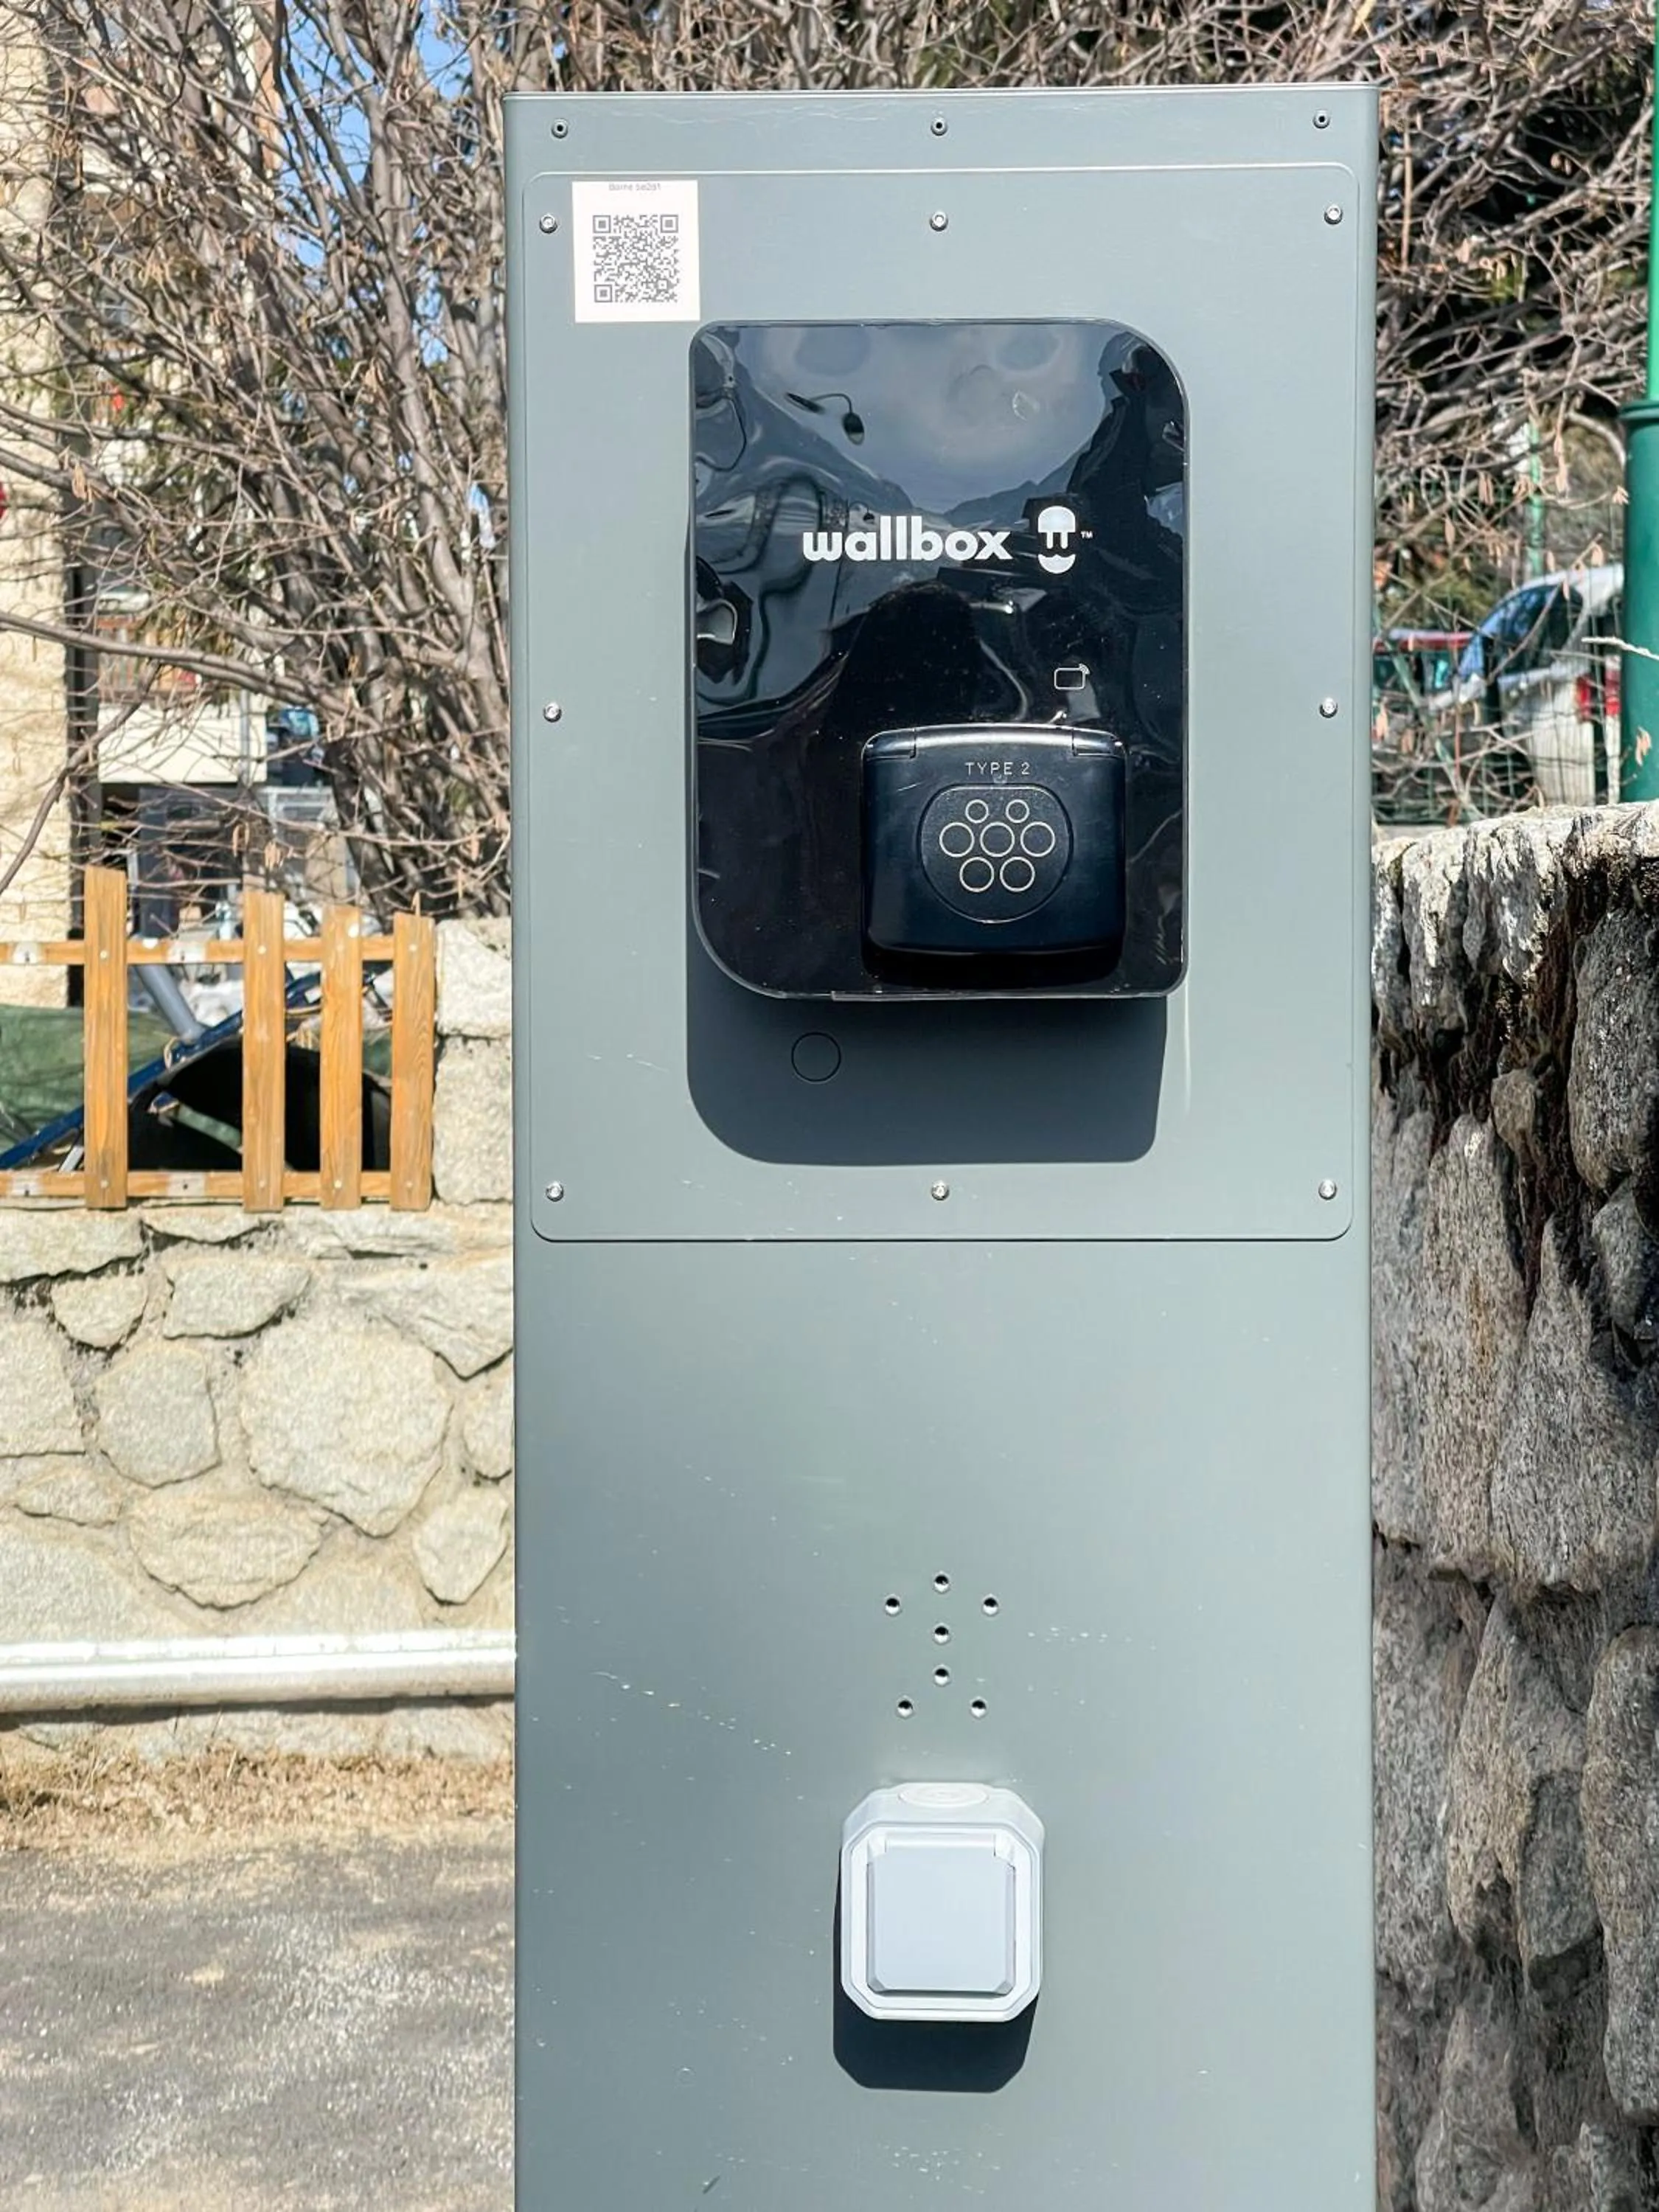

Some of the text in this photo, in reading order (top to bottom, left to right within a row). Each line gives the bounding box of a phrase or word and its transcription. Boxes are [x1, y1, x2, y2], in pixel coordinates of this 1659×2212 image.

[802, 515, 1012, 561] wallbox
[964, 762, 1031, 775] TYPE 2
